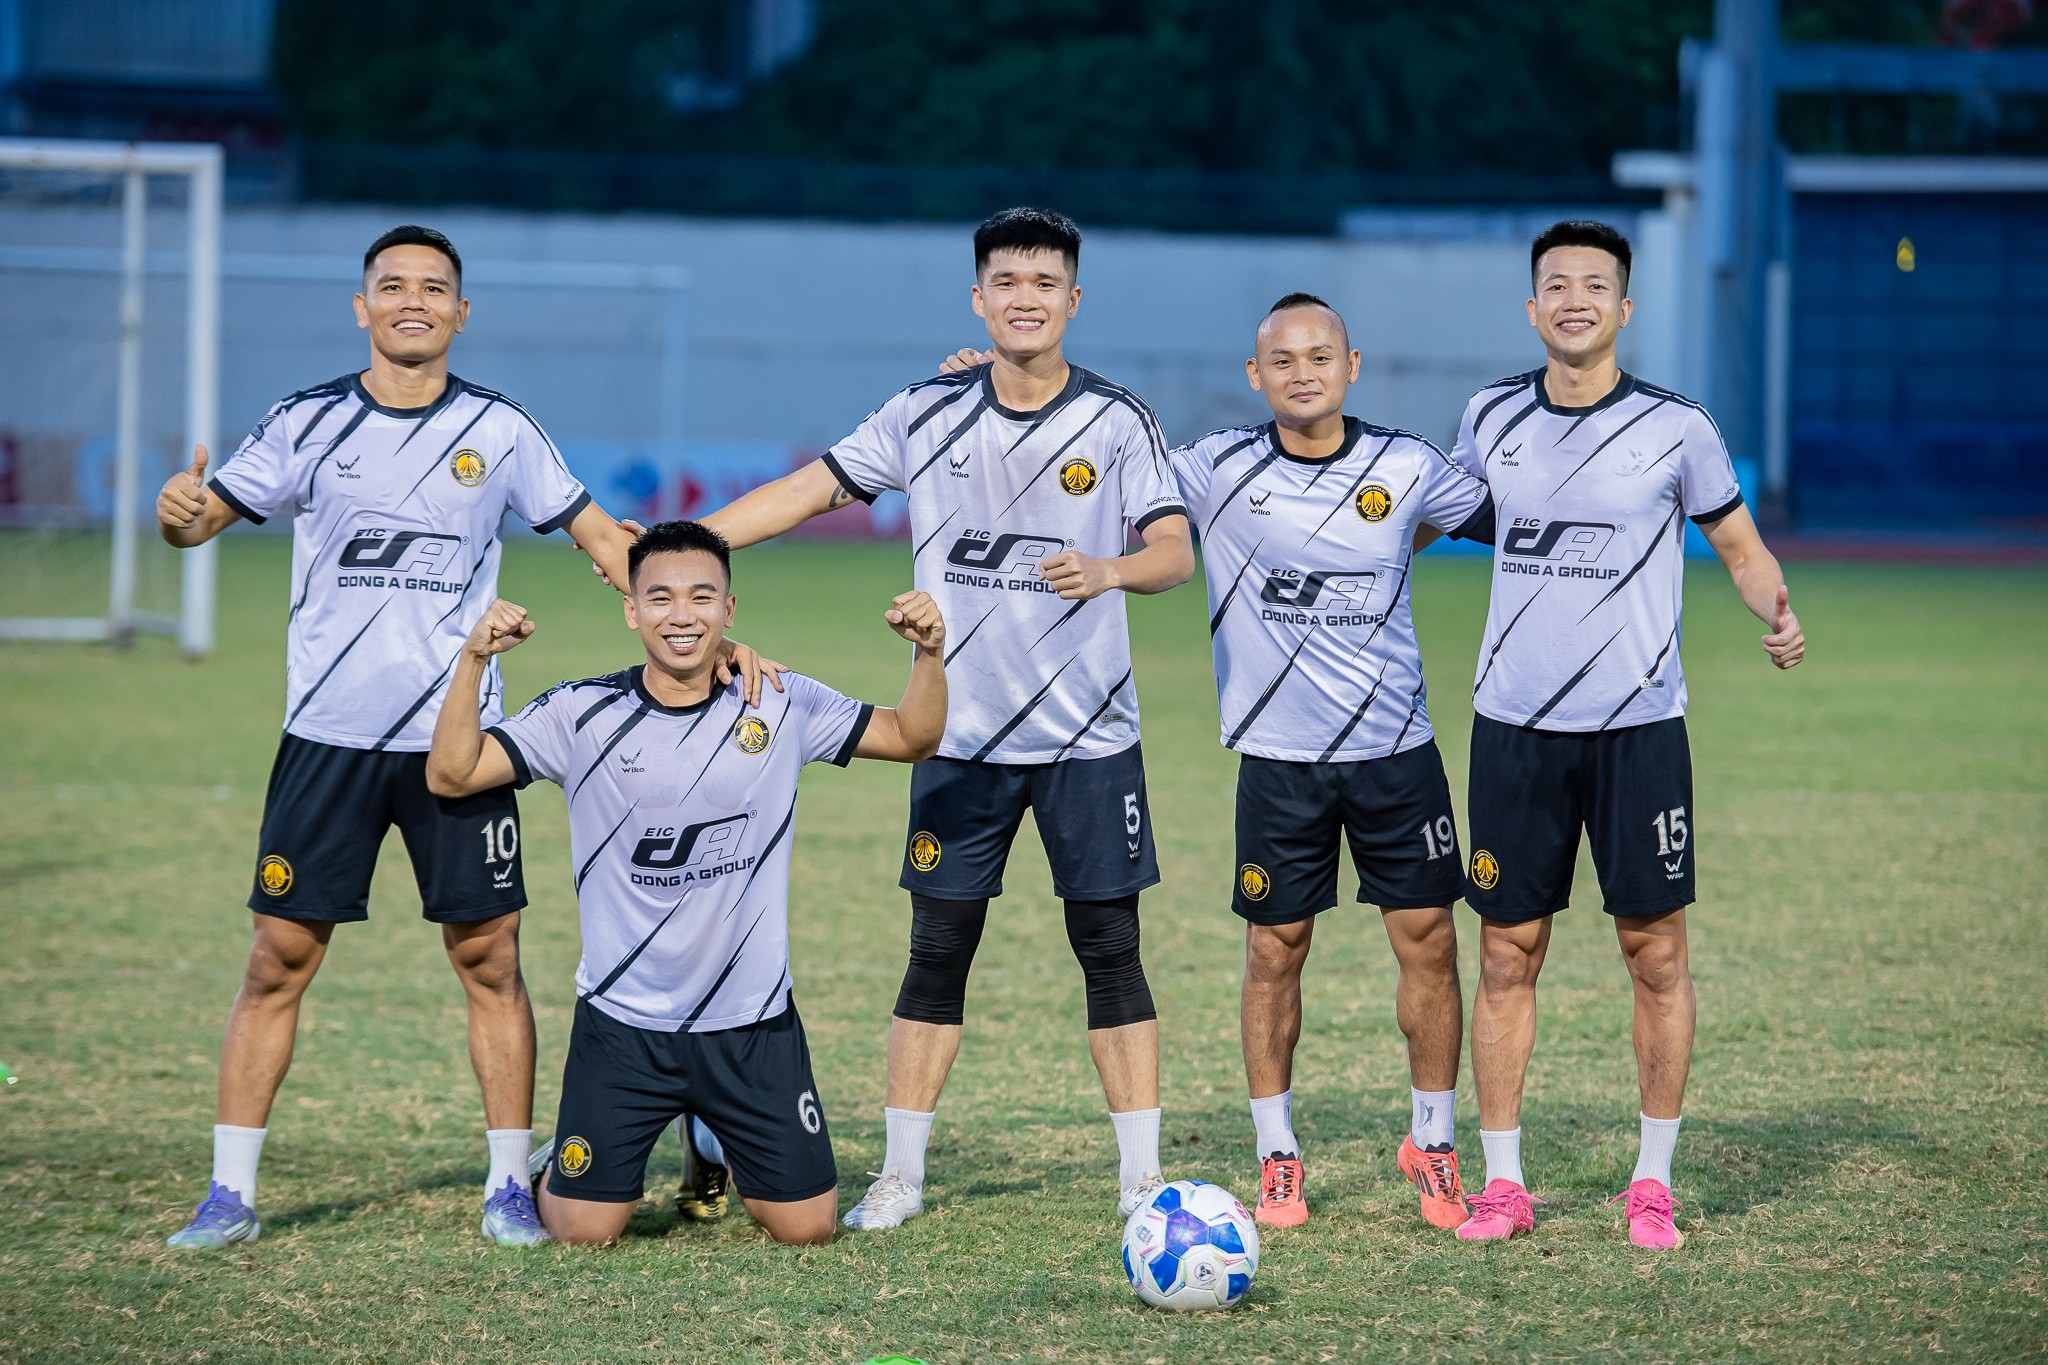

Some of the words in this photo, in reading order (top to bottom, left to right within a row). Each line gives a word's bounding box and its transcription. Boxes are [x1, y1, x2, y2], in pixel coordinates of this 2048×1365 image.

[1146, 496, 1172, 508] HONOR
[1512, 517, 1541, 528] EIC
[354, 528, 386, 538] EIC
[962, 528, 991, 540] EIC
[1270, 568, 1300, 578] EIC
[1501, 561, 1540, 575] DONG
[1541, 565, 1554, 577] A
[1558, 566, 1620, 580] GROUP
[337, 575, 385, 588] DONG
[388, 577, 401, 589] A
[405, 578, 463, 594] GROUP
[944, 571, 990, 588] DONG
[991, 578, 1005, 590] A
[1008, 579, 1060, 595] GROU
[1261, 609, 1307, 625] DONG
[1309, 615, 1322, 626] A
[1325, 613, 1384, 627] GROUP
[1123, 791, 1141, 835] 5
[480, 816, 518, 864] 10
[644, 827, 675, 837] EIC
[1419, 814, 1455, 861] 19
[1652, 805, 1688, 856] 15
[631, 872, 681, 888] DONG
[683, 871, 697, 884] A
[699, 856, 756, 880] GROUP
[797, 1089, 822, 1134] 6
